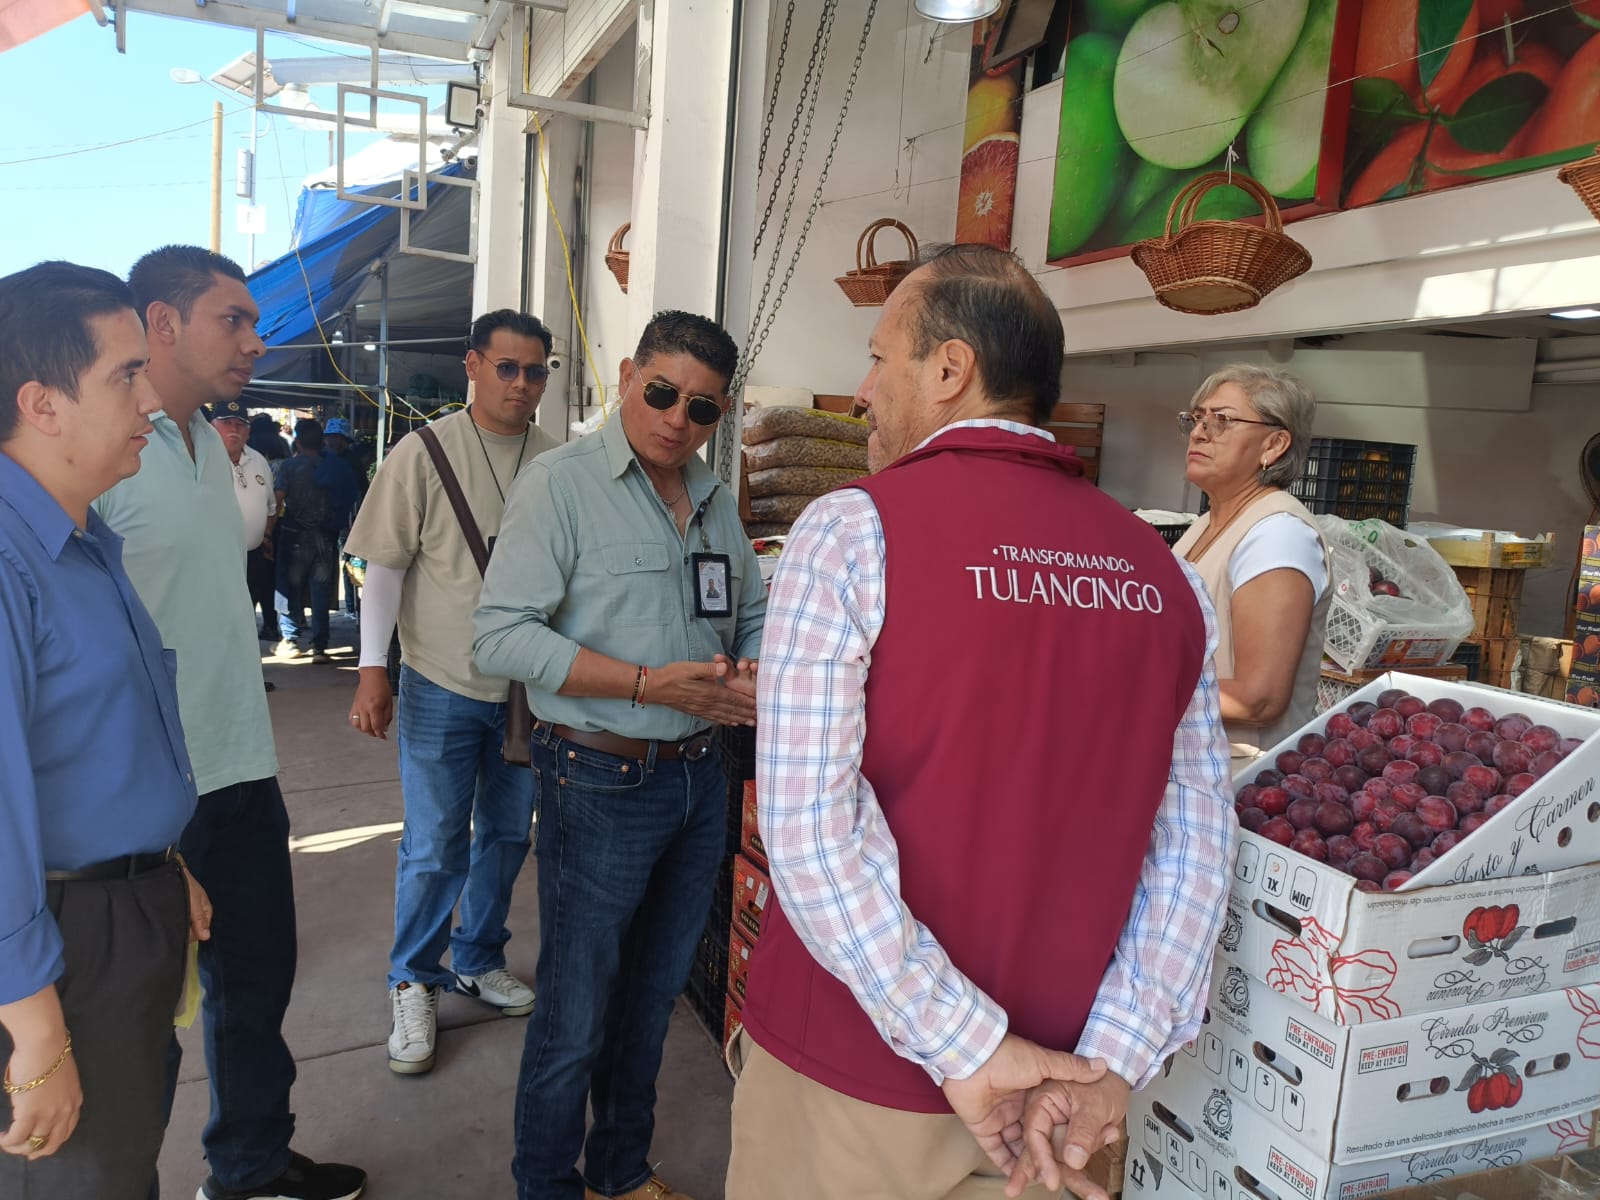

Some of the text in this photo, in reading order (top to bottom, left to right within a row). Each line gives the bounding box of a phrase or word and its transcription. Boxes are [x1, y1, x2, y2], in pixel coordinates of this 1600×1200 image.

[1000, 545, 1129, 573] TRANSFORMANDO
[965, 566, 1163, 614] TULANCINGO
[1514, 776, 1596, 843] Carmen
[1507, 835, 1524, 877] y
[1243, 865, 1248, 878] L
[1267, 877, 1279, 893] XL
[1291, 889, 1312, 908] JUM
[1410, 898, 1422, 907] de
[1423, 895, 1452, 905] mujeres
[1453, 892, 1466, 901] por
[1467, 892, 1487, 900] mano
[1426, 982, 1495, 1004] Premium
[1421, 1006, 1549, 1046] Ciruelas Premium
[1211, 1038, 1216, 1051] L
[1288, 1031, 1302, 1045] KEEP
[1302, 1040, 1310, 1050] AT
[1290, 1022, 1334, 1056] PRE-ENFRIADO
[1363, 1044, 1407, 1062] PRE-ENFRIADO
[1235, 1055, 1243, 1069] M
[1360, 1061, 1375, 1070] KEEP
[1375, 1059, 1382, 1067] AT
[1263, 1074, 1270, 1086] S
[1290, 1091, 1298, 1107] N
[1145, 1118, 1159, 1135] JUM
[1346, 1142, 1383, 1154] Resultado
[1384, 1138, 1395, 1148] de
[1396, 1137, 1410, 1145] una
[1411, 1129, 1443, 1143] delicada
[1443, 1123, 1477, 1137] selección
[1477, 1119, 1498, 1130] hecha
[1504, 1113, 1523, 1124] mano
[1524, 1111, 1537, 1121] por
[1536, 1106, 1560, 1117] mujeres
[1560, 1102, 1570, 1110] de
[1170, 1136, 1179, 1152] XL
[1462, 1137, 1528, 1160] Premium
[1195, 1158, 1201, 1170] L
[1269, 1160, 1283, 1174] KEEP
[1283, 1170, 1291, 1179] AT
[1271, 1151, 1314, 1189] PRE-ENFRIADO
[1219, 1177, 1227, 1191] M
[1342, 1176, 1387, 1195] PRE-ENFRIADO
